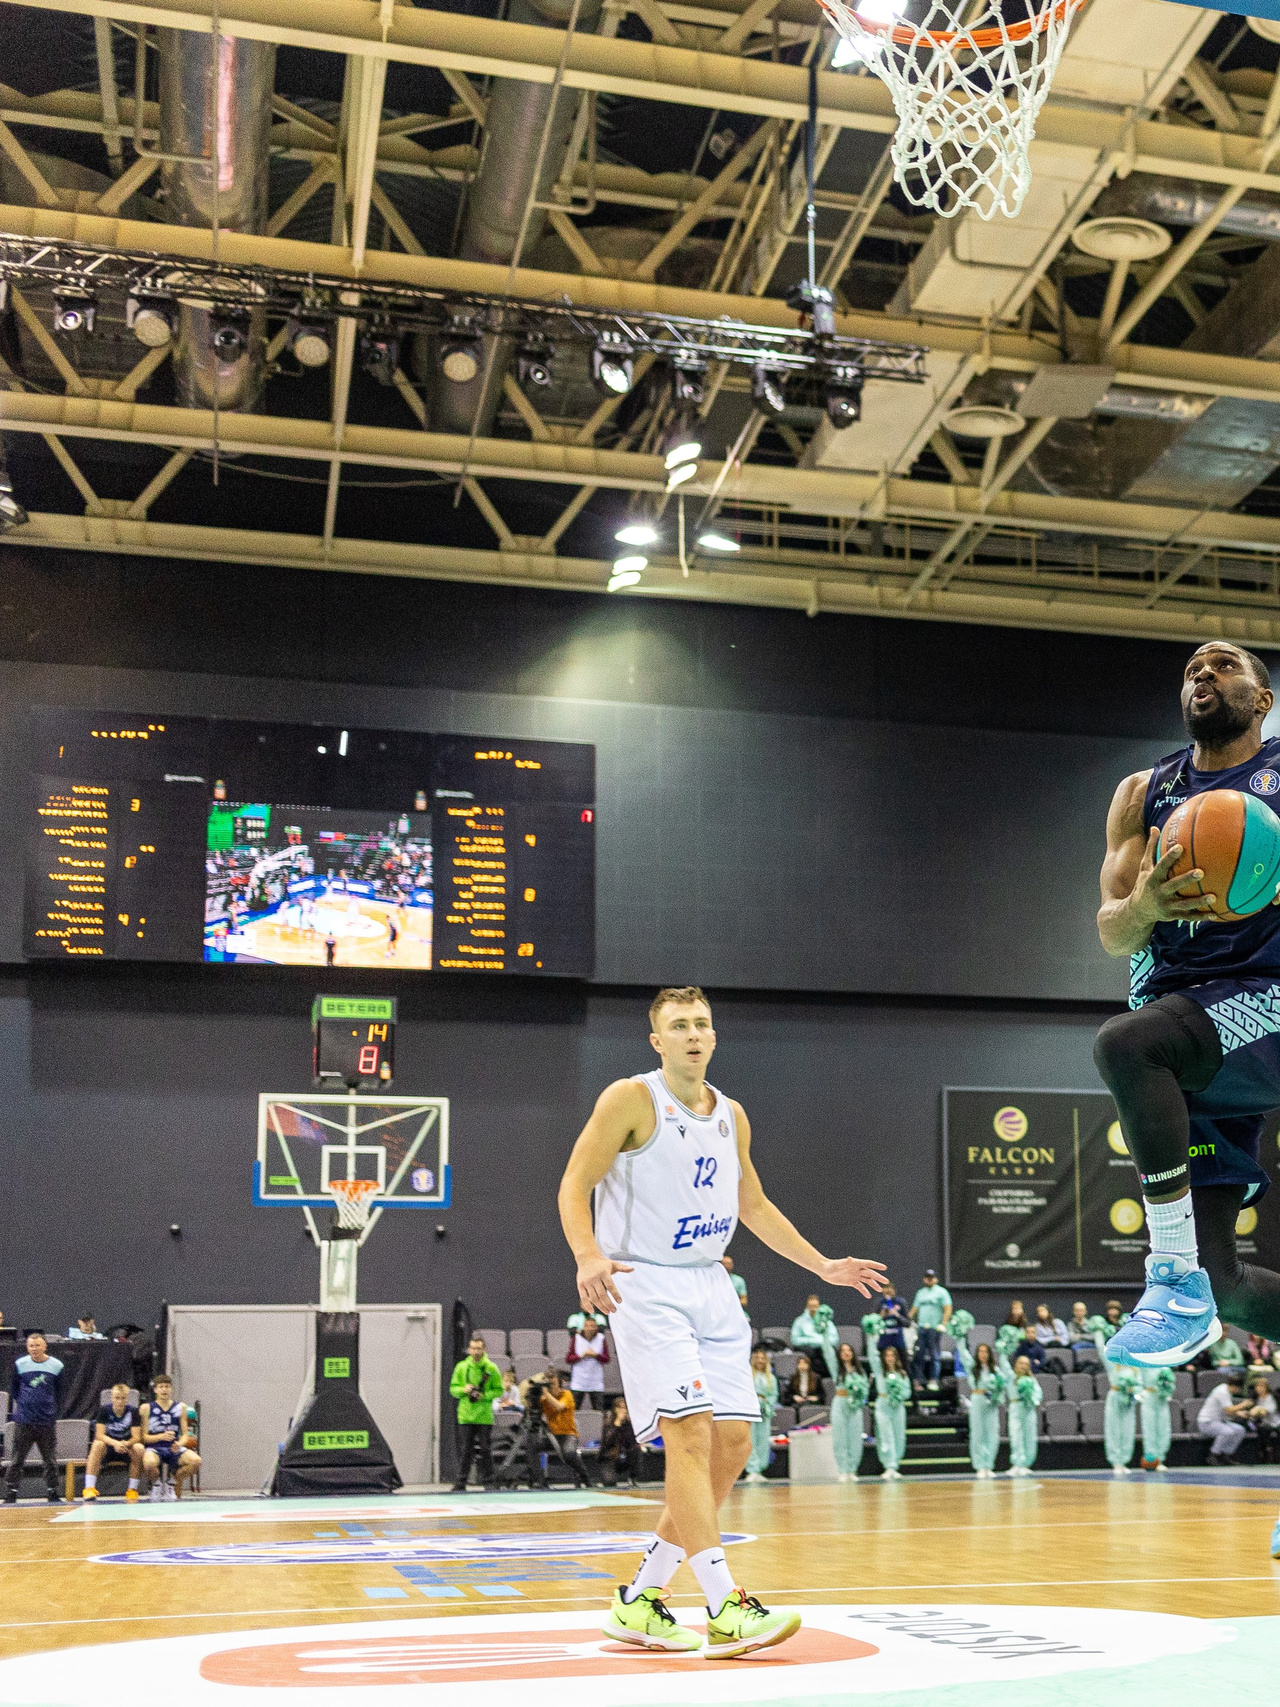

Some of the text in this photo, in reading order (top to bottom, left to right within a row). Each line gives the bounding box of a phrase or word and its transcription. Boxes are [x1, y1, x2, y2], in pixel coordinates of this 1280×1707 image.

[367, 1023, 388, 1042] 14
[358, 1045, 379, 1074] 8
[967, 1146, 1055, 1164] FALCON
[693, 1156, 718, 1188] 12
[1147, 1163, 1187, 1183] BLINDSAVE
[672, 1213, 732, 1250] Enisey
[307, 1434, 365, 1446] BETERA
